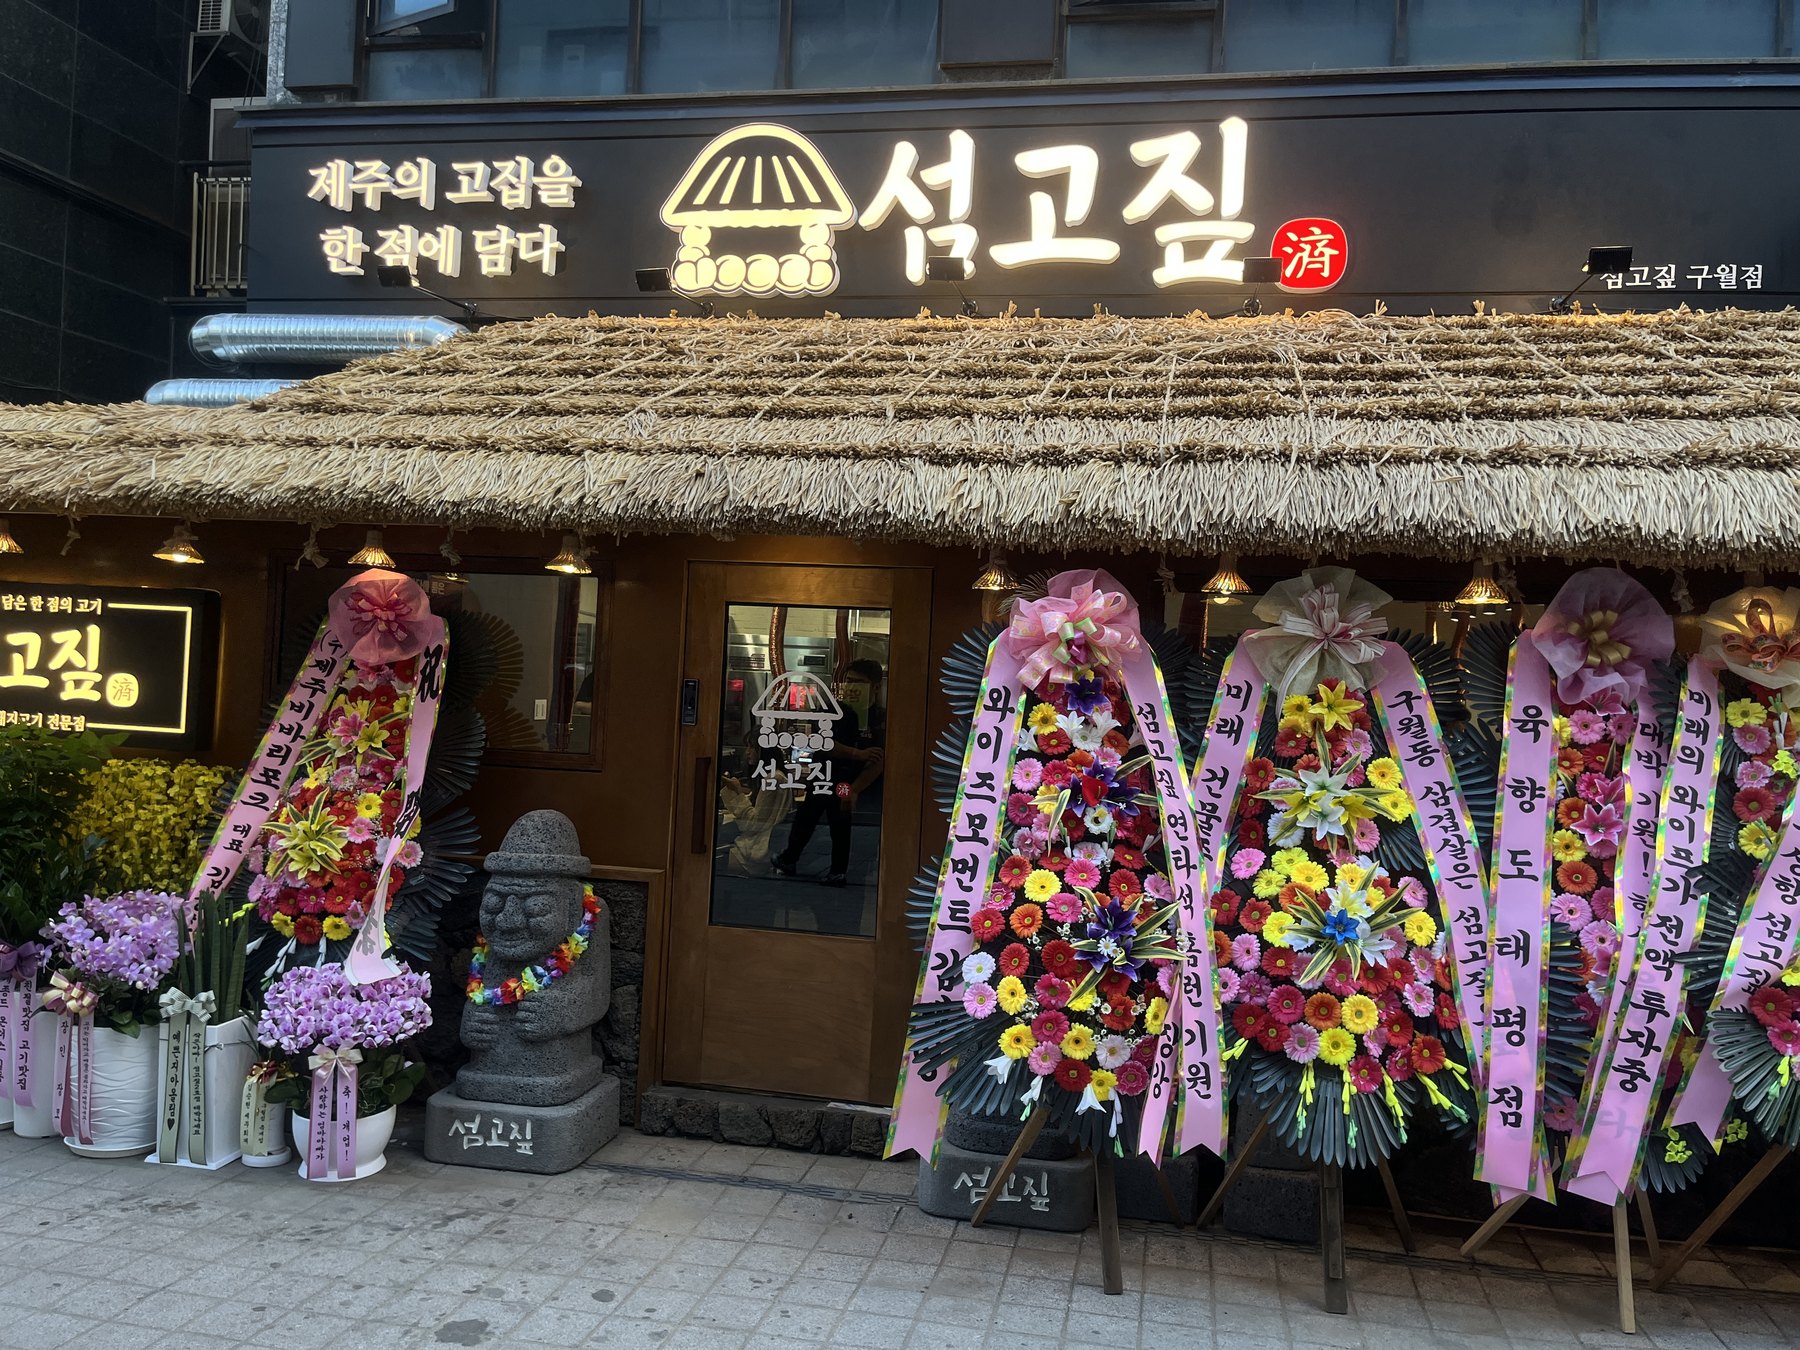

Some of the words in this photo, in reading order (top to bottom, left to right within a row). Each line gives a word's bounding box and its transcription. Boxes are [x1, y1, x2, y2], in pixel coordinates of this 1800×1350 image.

[308, 157, 436, 211] 제주의
[445, 155, 582, 210] 고집을
[858, 115, 1256, 288] 섬고짚
[319, 225, 370, 276] 한
[374, 224, 462, 277] 점에
[472, 224, 566, 277] 담다
[1686, 264, 1763, 290] 구월점
[1, 594, 27, 611] 담은
[30, 595, 44, 612] 한
[47, 596, 72, 613] 점의
[76, 598, 102, 615] 고기
[47, 713, 86, 732] 전문점
[1137, 702, 1180, 799] 섬고짚
[751, 758, 834, 795] 섬고짚
[1387, 690, 1440, 768] 구월동
[1419, 780, 1479, 890] 삼겹살은
[937, 684, 1016, 934] 와이즈모먼트
[223, 822, 252, 855] 대표
[1168, 808, 1198, 920] 연타석
[1183, 931, 1203, 1008] 홈런
[17, 1040, 30, 1090] 고기맛집
[1184, 1019, 1212, 1099] 기원
[1612, 989, 1671, 1094] 투자중
[448, 1113, 534, 1155] 섬고짚
